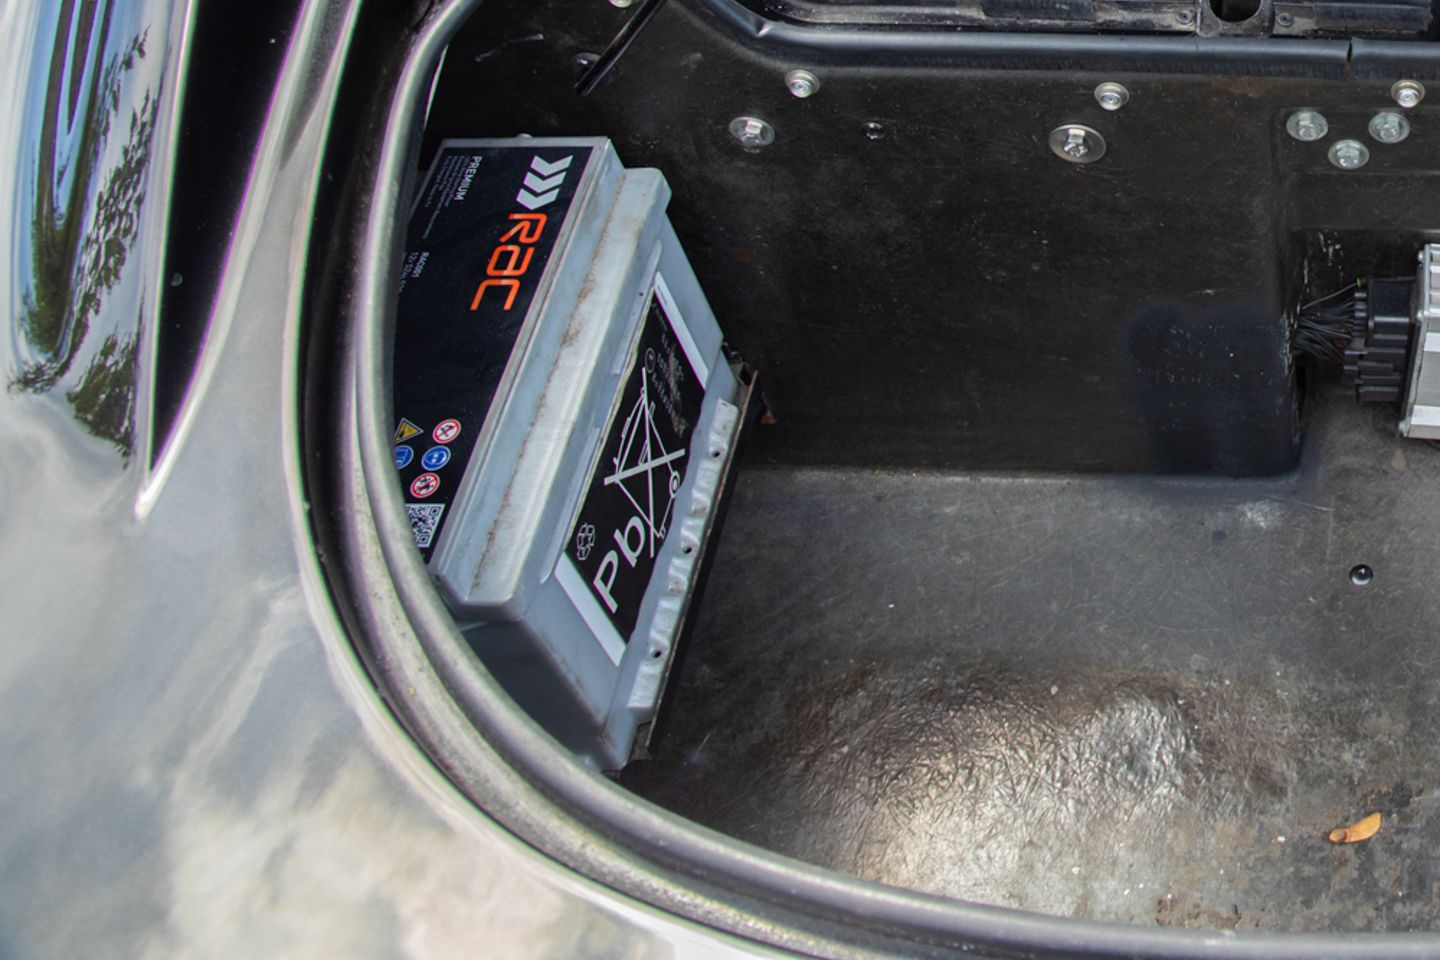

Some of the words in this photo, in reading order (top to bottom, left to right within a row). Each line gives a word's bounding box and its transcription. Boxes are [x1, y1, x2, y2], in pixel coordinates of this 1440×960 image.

[453, 155, 482, 201] PREMIUM
[470, 212, 548, 311] RAC
[592, 514, 647, 614] Pb
